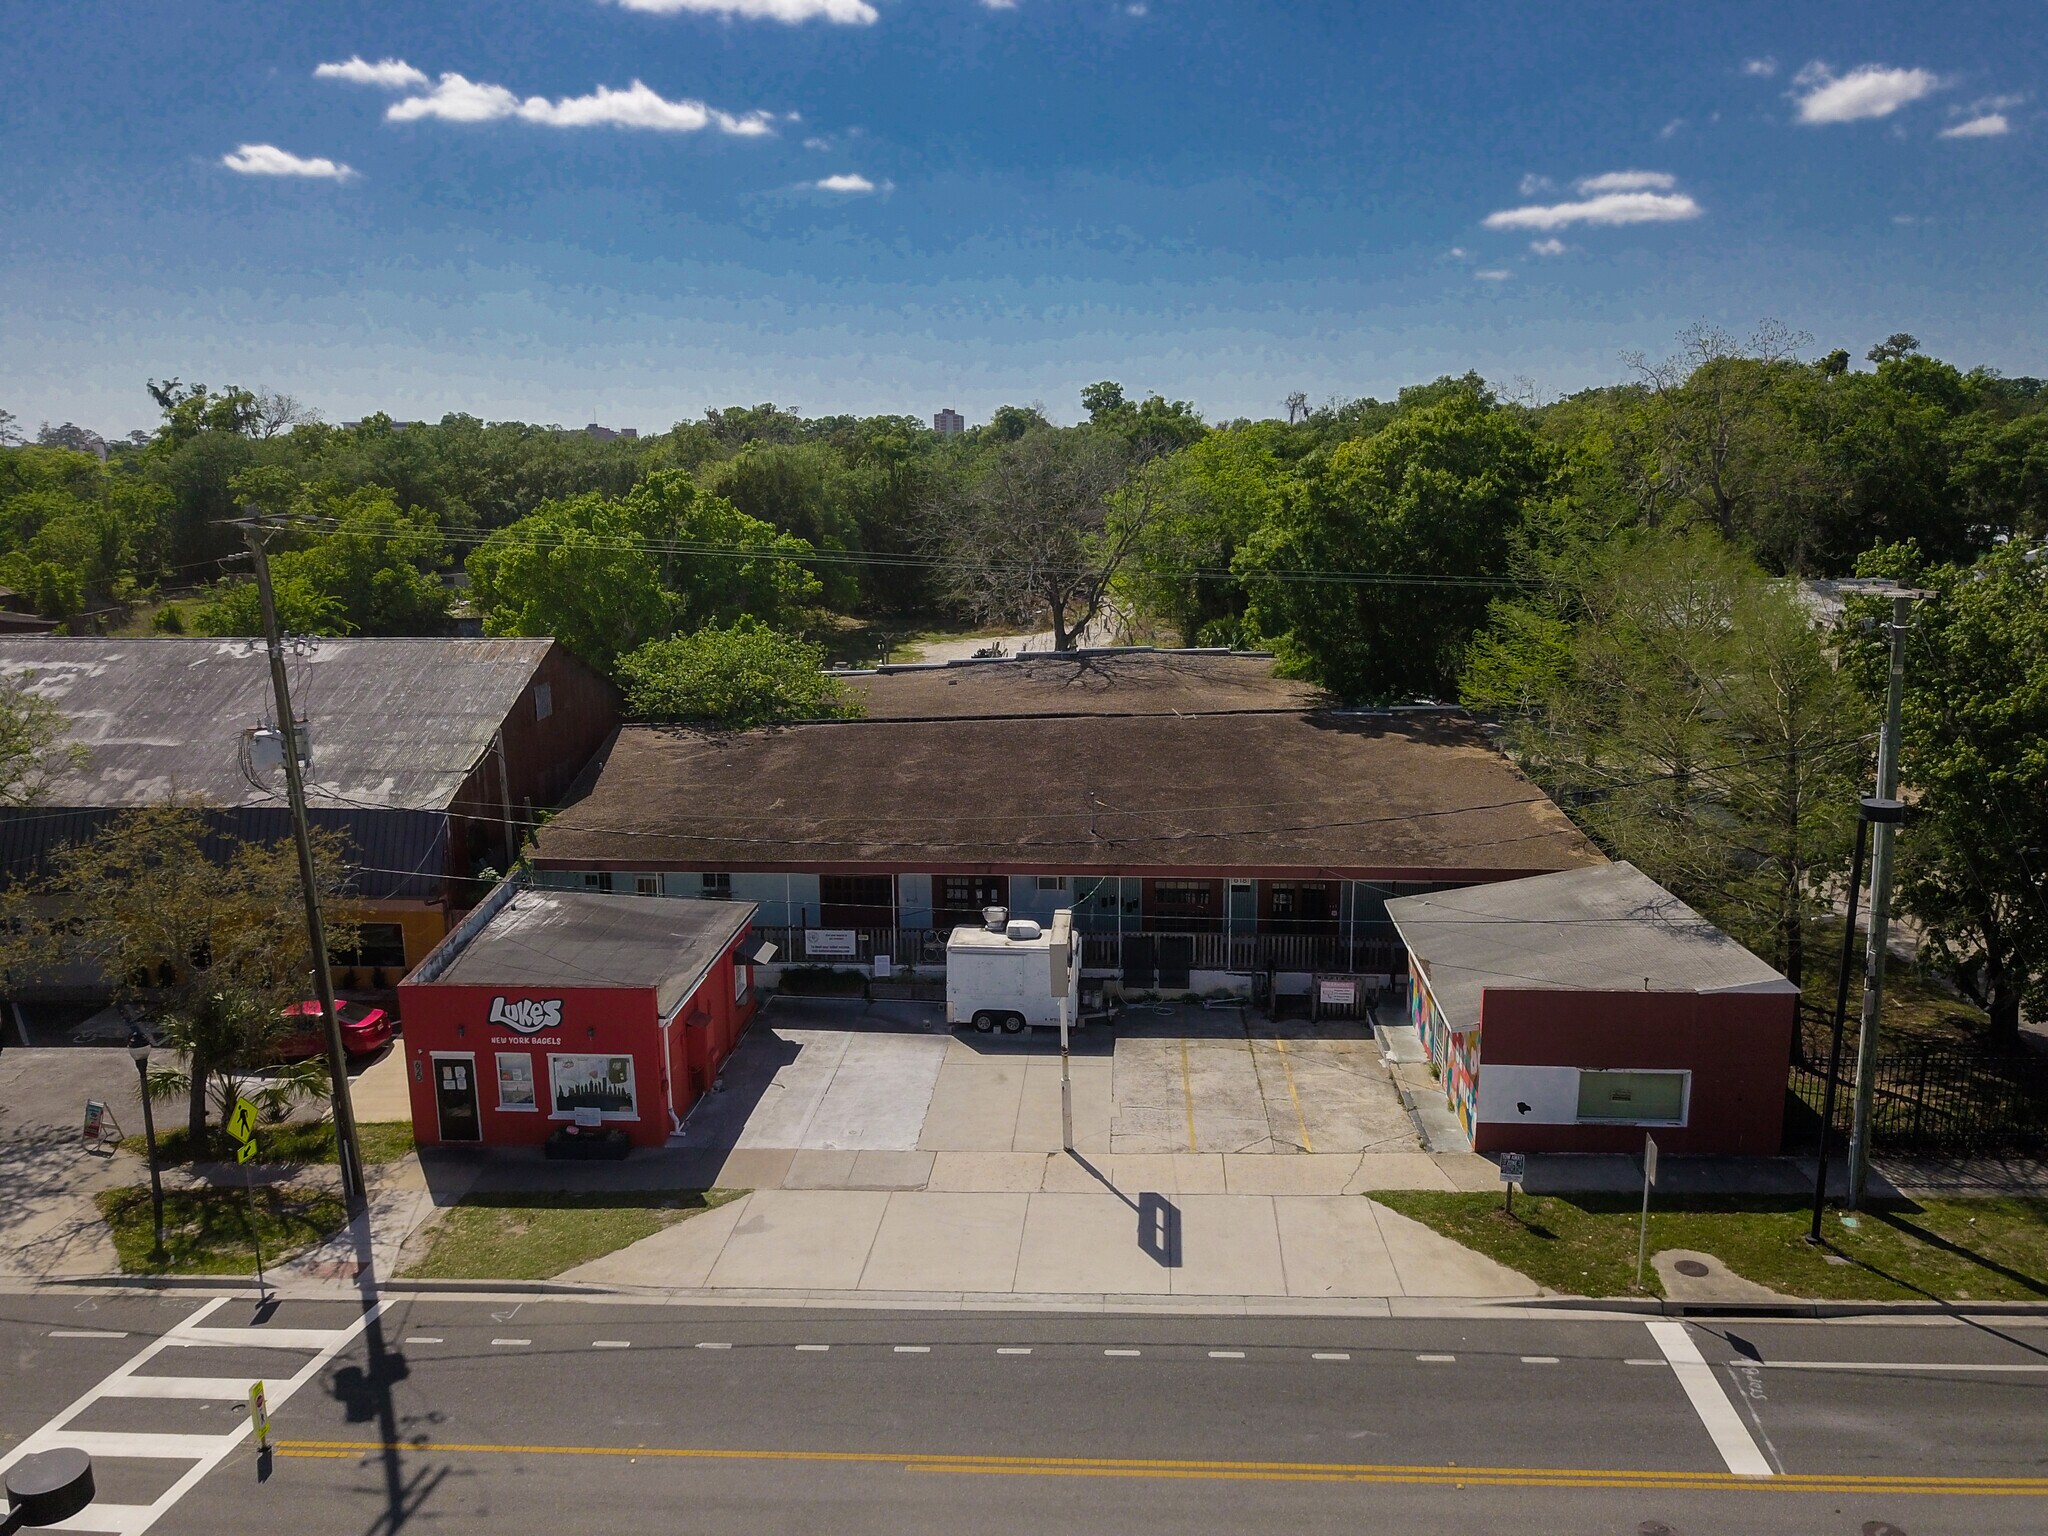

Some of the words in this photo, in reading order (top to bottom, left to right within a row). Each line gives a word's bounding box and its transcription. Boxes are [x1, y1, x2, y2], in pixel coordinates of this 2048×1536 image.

[491, 1037, 507, 1045] NEW
[509, 1037, 530, 1045] YORK
[532, 1037, 562, 1046] BAGELS
